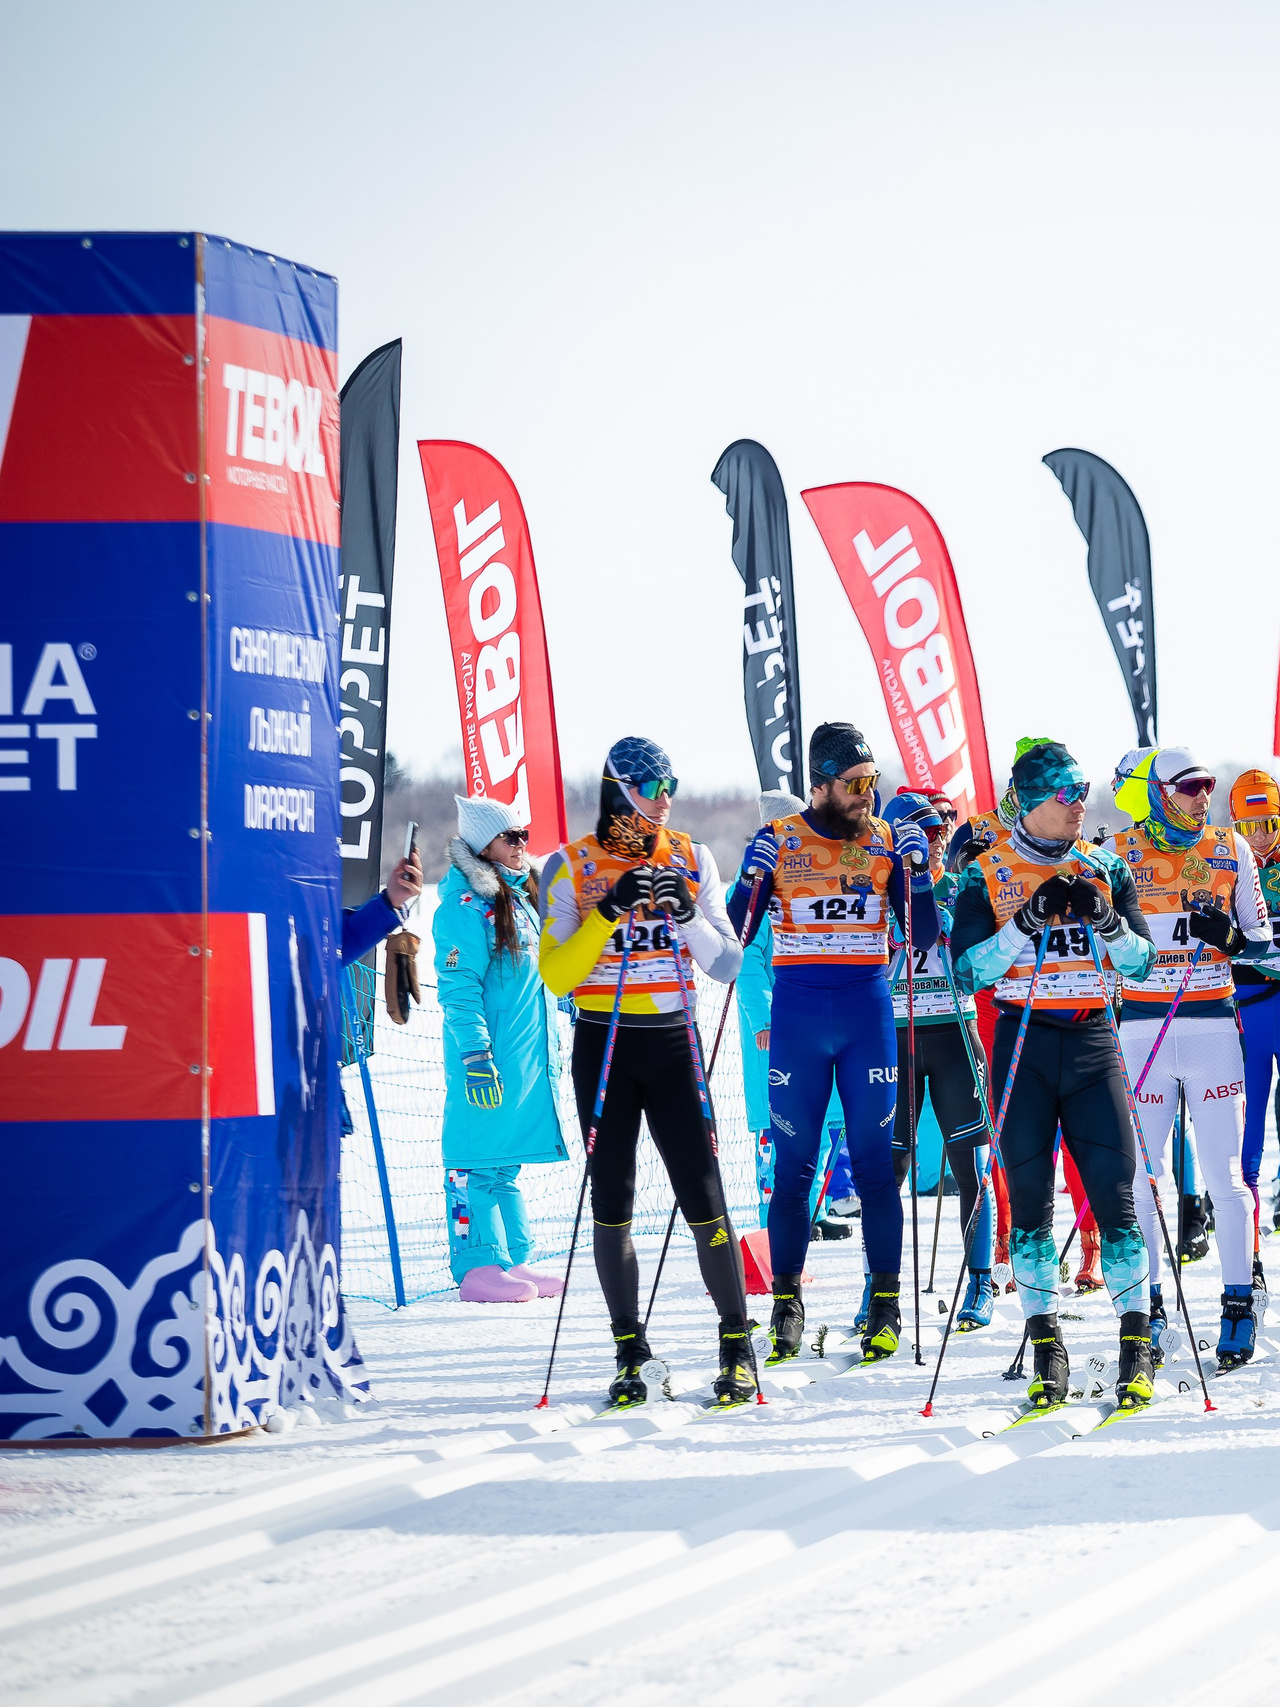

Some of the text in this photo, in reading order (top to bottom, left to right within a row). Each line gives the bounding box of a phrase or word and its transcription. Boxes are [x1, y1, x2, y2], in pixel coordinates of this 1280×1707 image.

[223, 363, 326, 478] TEBOIL
[338, 574, 385, 860] LOPPET
[244, 784, 314, 833] МАРАФОН
[1182, 855, 1211, 884] 25
[808, 898, 866, 920] 124
[611, 924, 674, 953] 126
[1156, 952, 1212, 964] диев Оар
[645, 1366, 663, 1381] 126
[1088, 1355, 1105, 1373] 149
